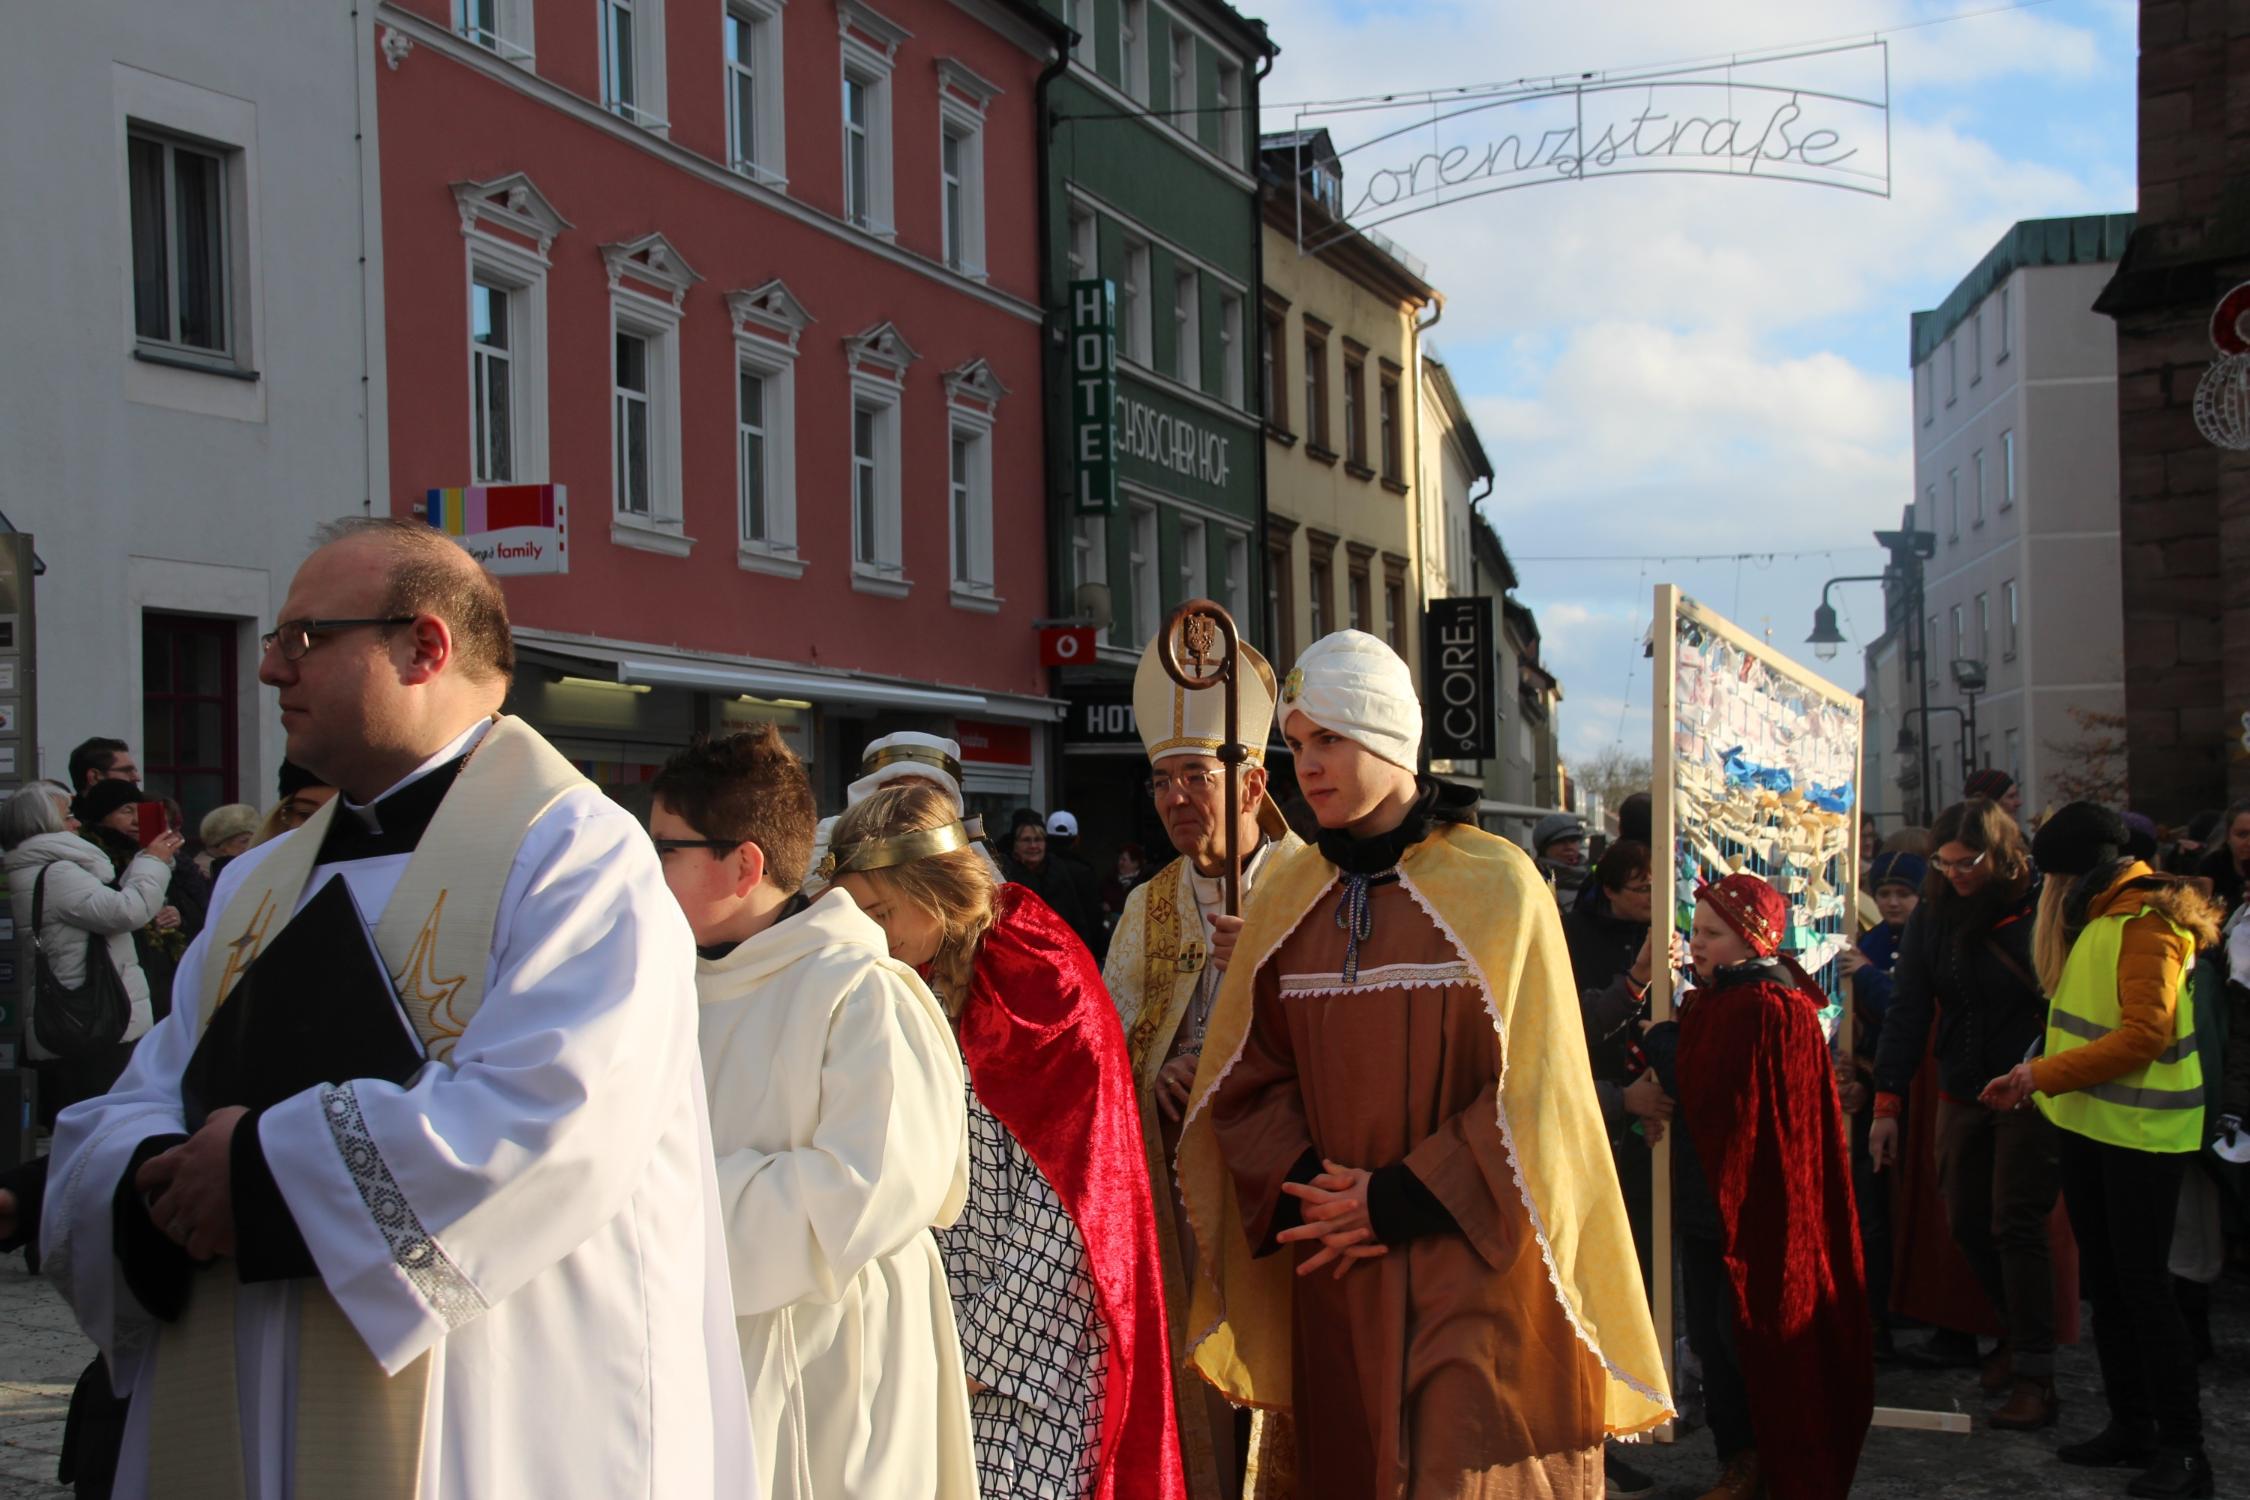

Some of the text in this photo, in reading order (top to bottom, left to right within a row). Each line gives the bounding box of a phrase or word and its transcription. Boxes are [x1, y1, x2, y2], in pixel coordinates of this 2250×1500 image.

[1075, 288, 1103, 506] HOTEL
[1199, 428, 1230, 488] HOF
[497, 541, 543, 560] family
[1087, 705, 1136, 733] HOT
